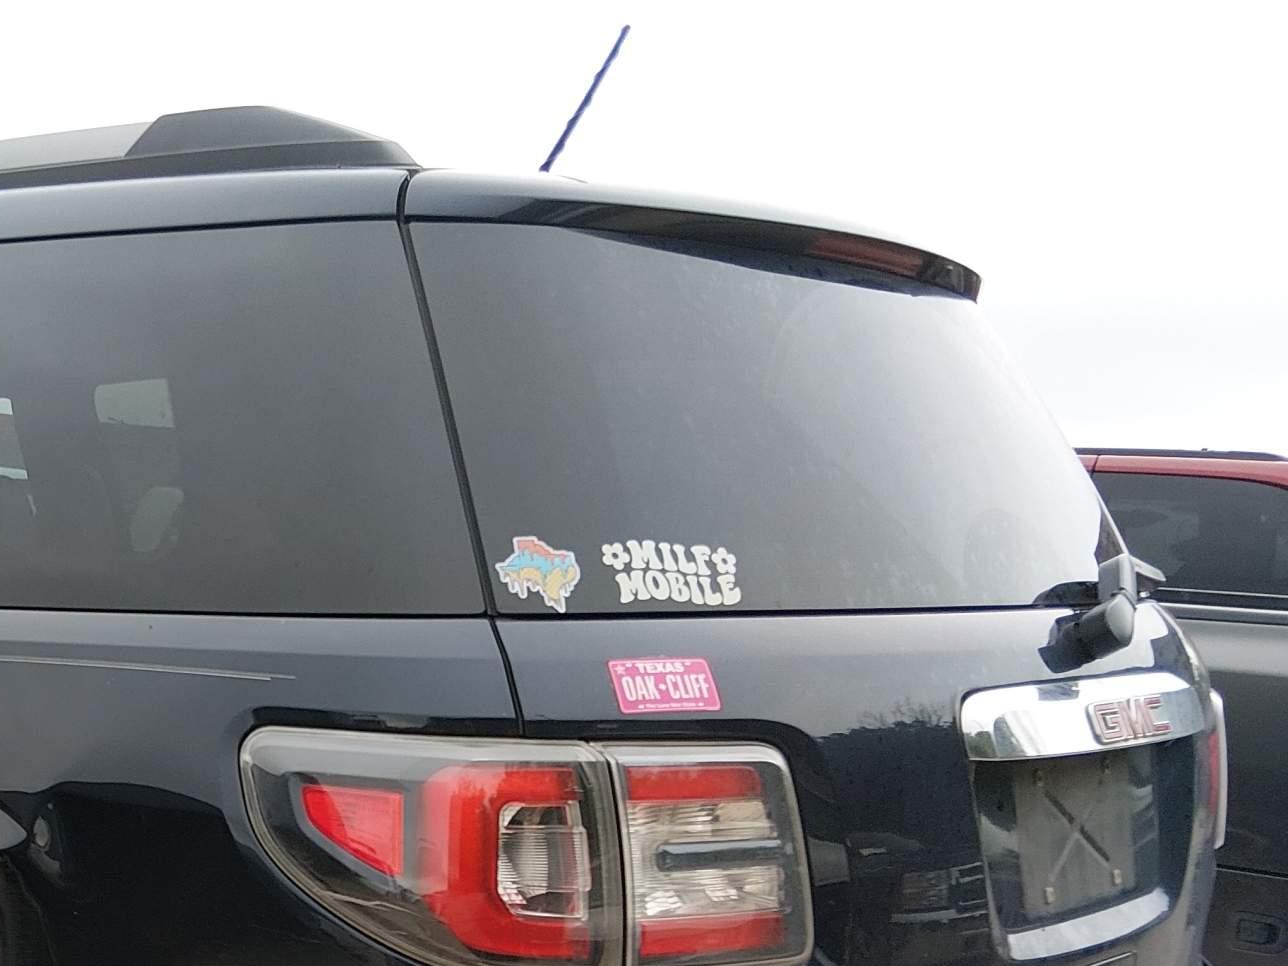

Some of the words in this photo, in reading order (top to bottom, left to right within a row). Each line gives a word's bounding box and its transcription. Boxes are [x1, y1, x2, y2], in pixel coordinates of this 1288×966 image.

[626, 540, 712, 576] MILF
[615, 569, 742, 606] MOBILE
[635, 661, 685, 673] TEXAS
[1092, 695, 1172, 742] GMC
